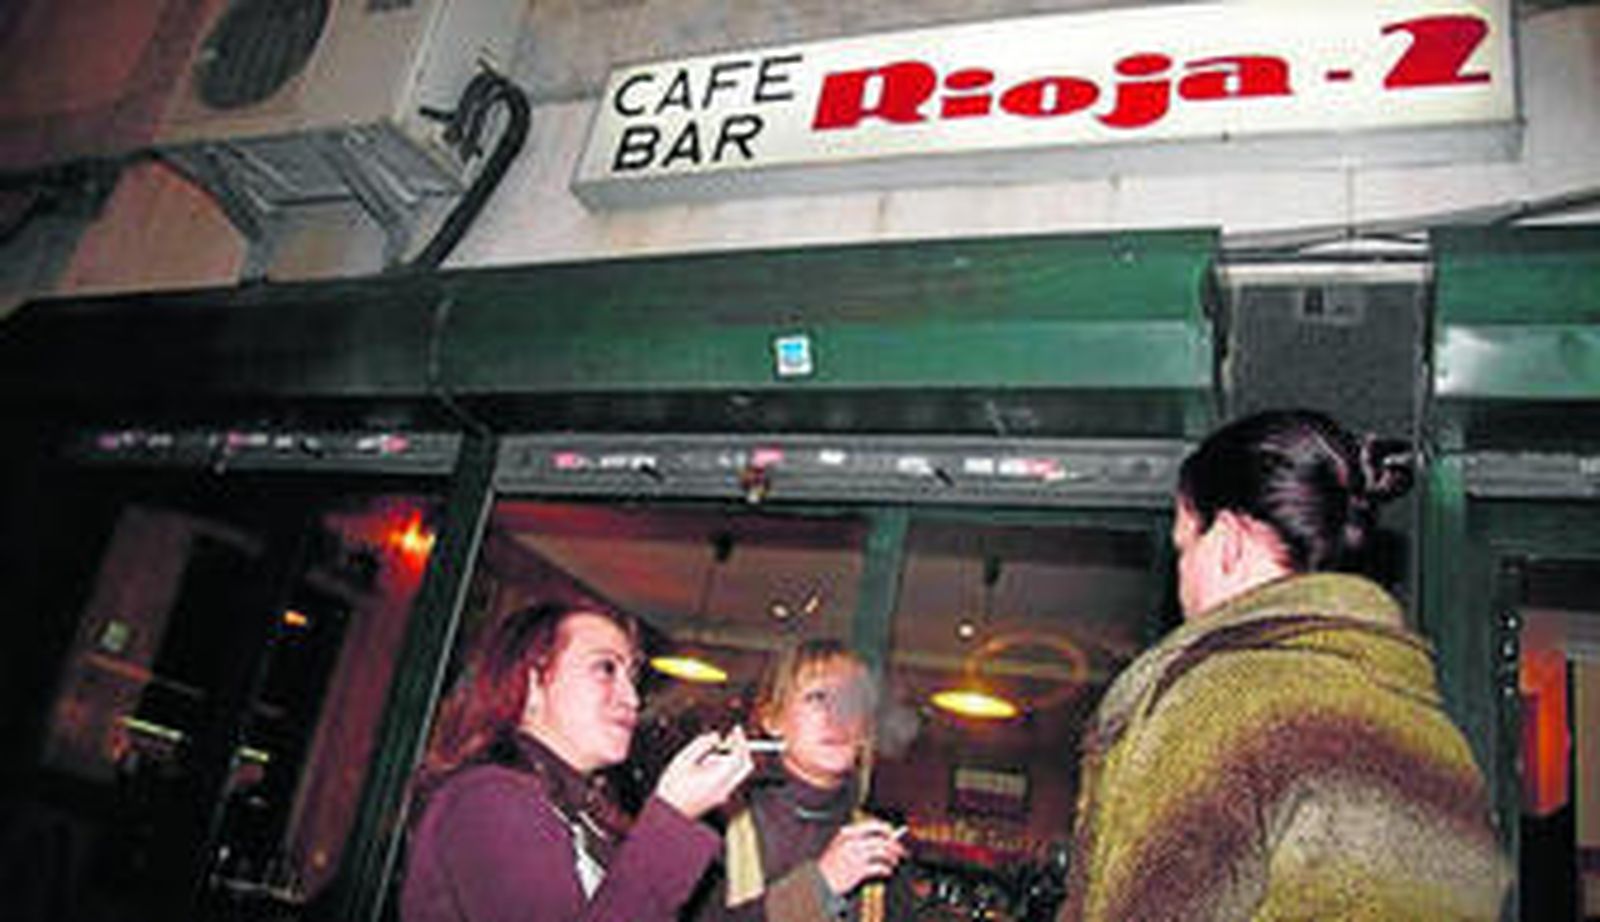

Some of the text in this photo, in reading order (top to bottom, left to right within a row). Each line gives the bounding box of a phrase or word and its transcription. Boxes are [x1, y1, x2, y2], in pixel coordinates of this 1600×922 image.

[613, 55, 803, 117] CAFE
[811, 53, 1294, 130] Rioja
[612, 115, 765, 172] BAR
